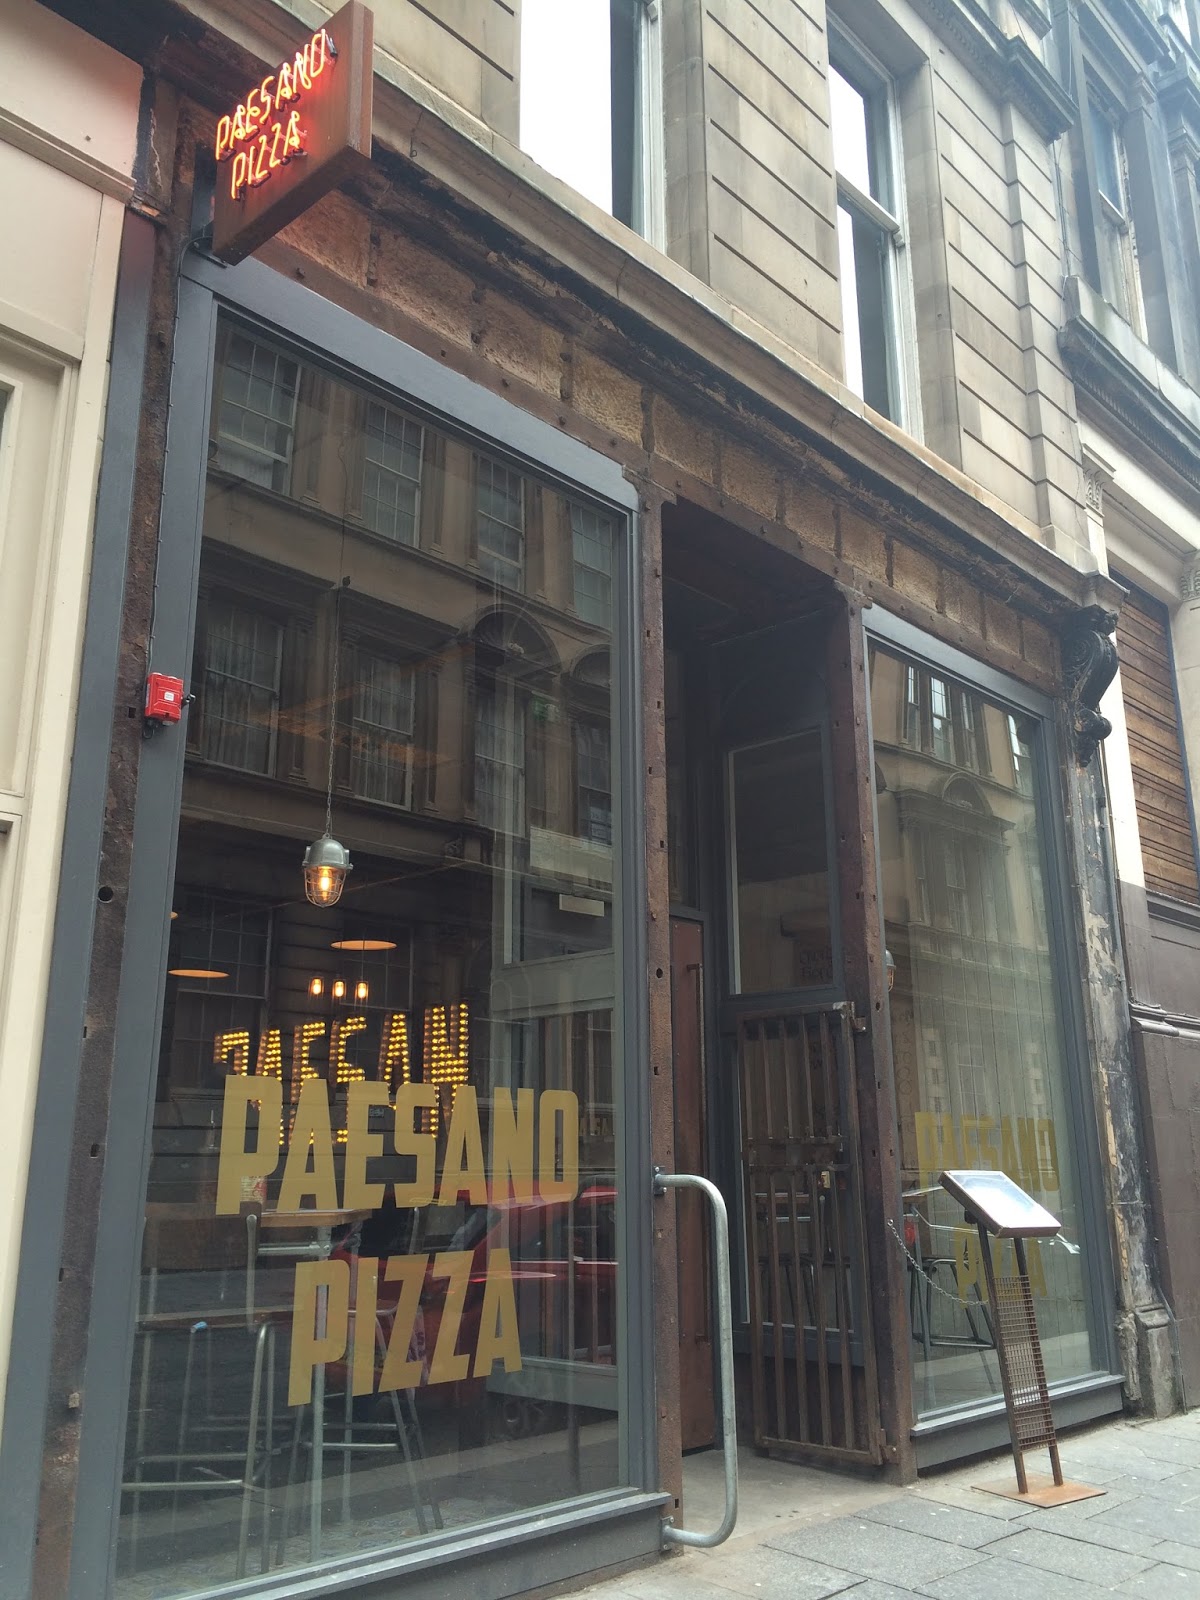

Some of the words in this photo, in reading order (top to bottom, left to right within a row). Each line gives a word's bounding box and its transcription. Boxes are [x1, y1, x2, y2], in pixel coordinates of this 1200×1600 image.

[215, 28, 326, 160] PAESANO
[231, 110, 300, 200] PIZZA
[216, 1074, 579, 1215] PAESANO
[288, 1248, 522, 1406] PIZZA
